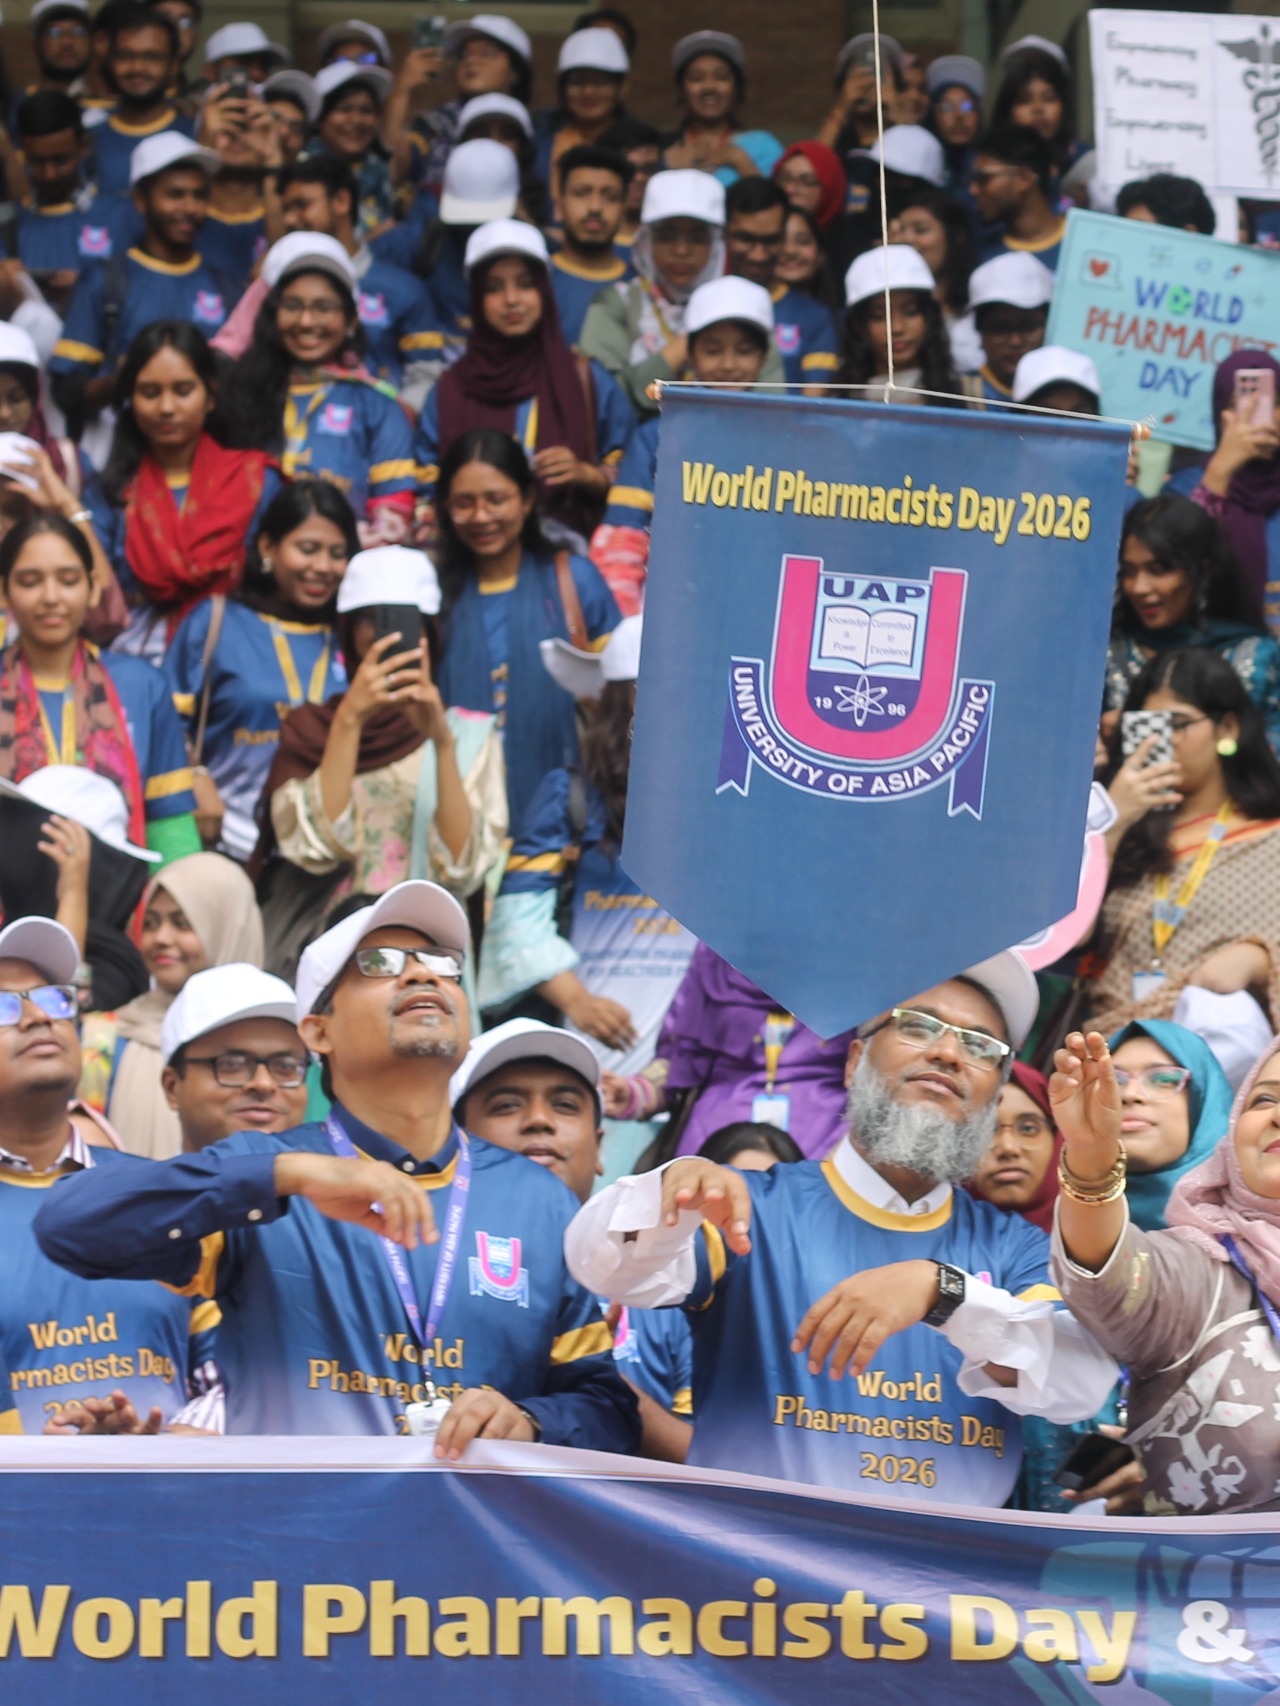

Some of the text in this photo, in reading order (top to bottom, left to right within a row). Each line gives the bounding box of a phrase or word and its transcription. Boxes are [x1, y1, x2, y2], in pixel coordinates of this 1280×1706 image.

[1084, 306, 1279, 367] PHARMACI
[1139, 361, 1201, 398] DAY
[682, 461, 1091, 545] World Pharmacists Day 2026
[823, 578, 926, 603] UAP
[814, 696, 832, 709] 19
[888, 703, 906, 716] 96
[734, 666, 990, 795] UNIVERSITY OF ASIA PACIFIC
[28, 1311, 119, 1350] World
[9, 1347, 175, 1391] rmacists Day
[380, 1332, 465, 1369] World
[308, 1358, 463, 1405] Pharmacst
[856, 1370, 942, 1403] World
[773, 1395, 1006, 1458] Pharmacists Day
[860, 1451, 937, 1488] 2026
[0, 1580, 278, 1660] World
[303, 1577, 929, 1661] Pharmacists
[949, 1594, 1137, 1684] Day
[1177, 1600, 1255, 1664] &
